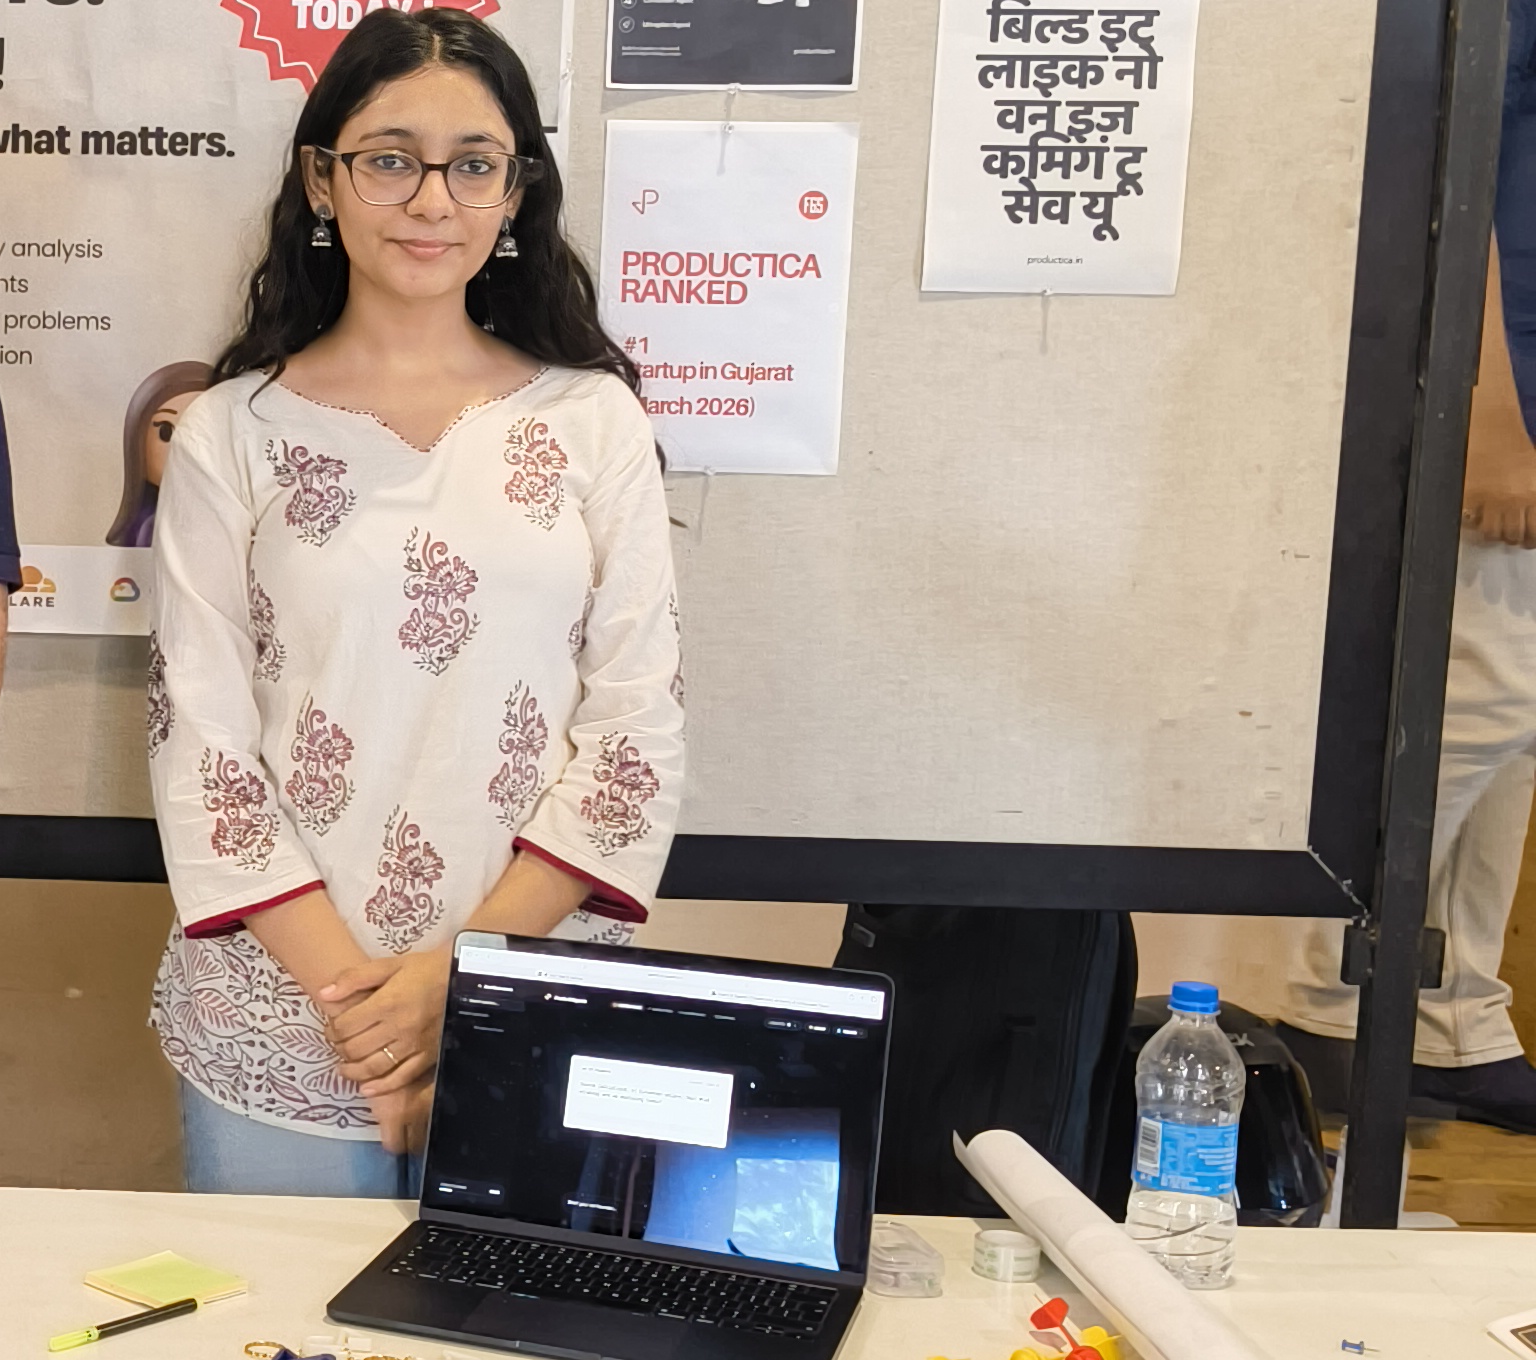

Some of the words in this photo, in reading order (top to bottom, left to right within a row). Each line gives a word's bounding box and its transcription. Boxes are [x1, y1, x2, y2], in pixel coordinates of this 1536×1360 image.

[1097, 10, 1161, 54] इट
[975, 54, 1109, 98] लाइक
[1112, 43, 1164, 90] नो
[993, 100, 1063, 134] वन
[81, 125, 236, 158] matters.
[1113, 146, 1148, 196] टू
[1001, 176, 1076, 225] सेव
[1079, 191, 1120, 242] यू
[11, 239, 104, 264] analysis
[622, 250, 822, 279] PRODUCTICA
[620, 278, 748, 305] RANKED
[4, 311, 112, 335] problems
[624, 336, 649, 354] #1
[634, 361, 697, 384] tartup
[699, 361, 718, 380] in
[721, 362, 795, 386] Gujarat
[695, 396, 755, 418] 2026)
